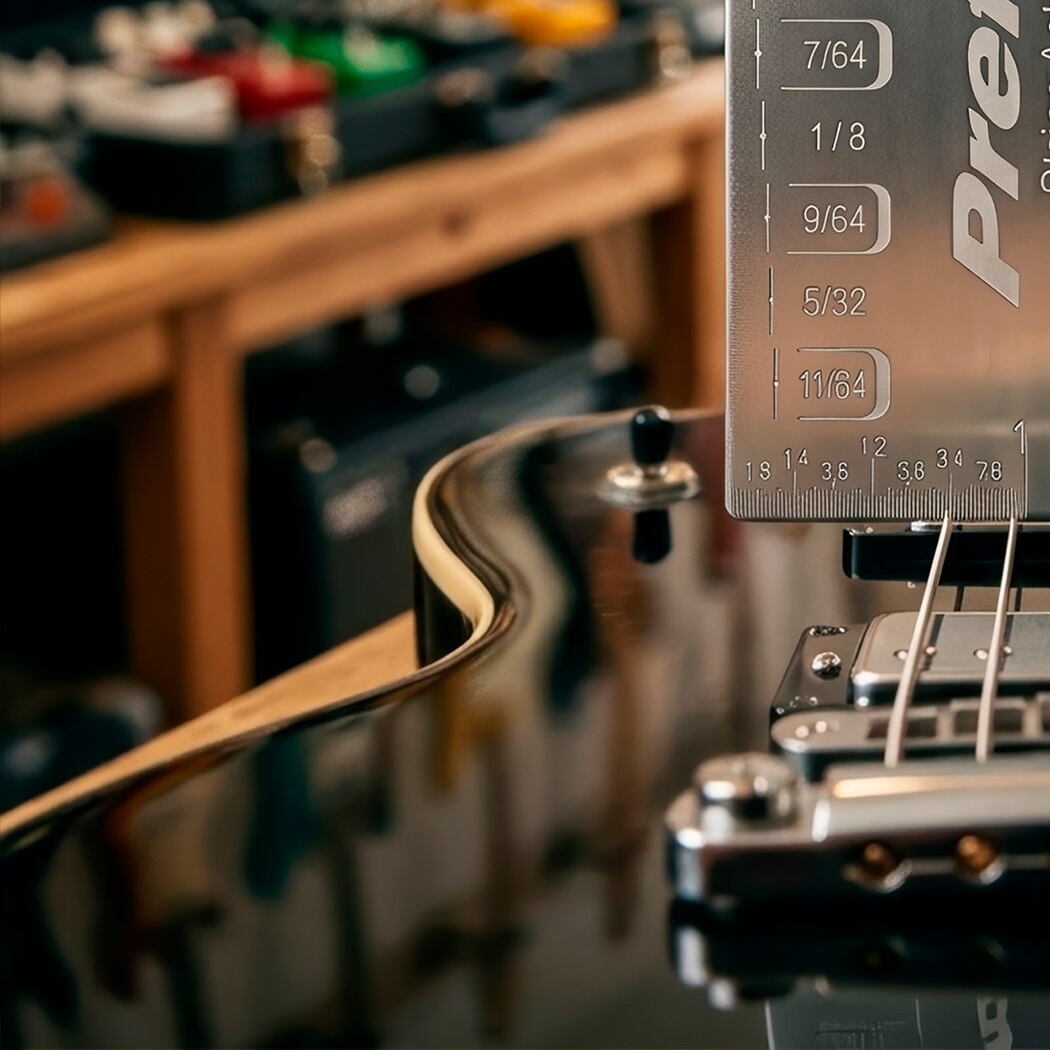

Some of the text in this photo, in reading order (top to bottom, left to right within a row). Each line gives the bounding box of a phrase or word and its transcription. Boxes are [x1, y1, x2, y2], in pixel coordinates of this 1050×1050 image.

[803, 40, 868, 70] 7/64
[802, 204, 867, 234] 9/64
[801, 286, 867, 317] 5/32
[799, 369, 866, 400] 11/64
